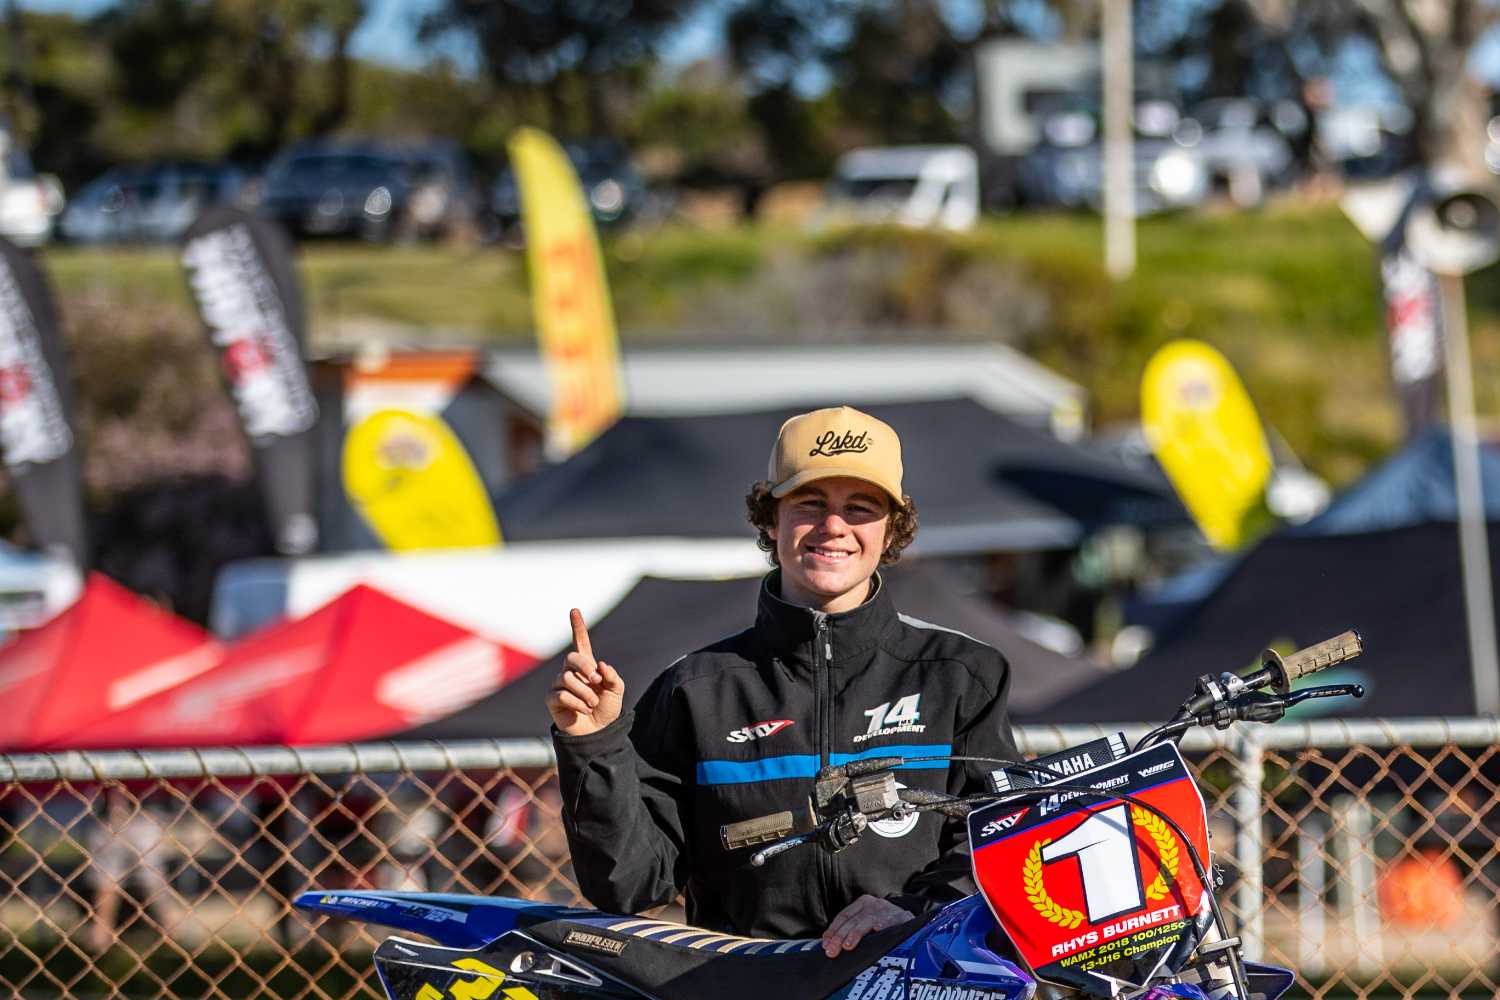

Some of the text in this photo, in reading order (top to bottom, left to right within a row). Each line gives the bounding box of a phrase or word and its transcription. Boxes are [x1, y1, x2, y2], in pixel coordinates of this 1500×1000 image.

[809, 430, 868, 457] Lskd
[864, 694, 921, 733] 14
[853, 724, 927, 743] DEVELOPMENT
[1036, 792, 1061, 817] 14
[1040, 803, 1145, 925] 1
[1051, 905, 1182, 957] RHYS BURNETT
[1060, 952, 1096, 968] WAMX
[1099, 938, 1130, 956] 2018
[1080, 934, 1182, 973] 13-U16 Champion
